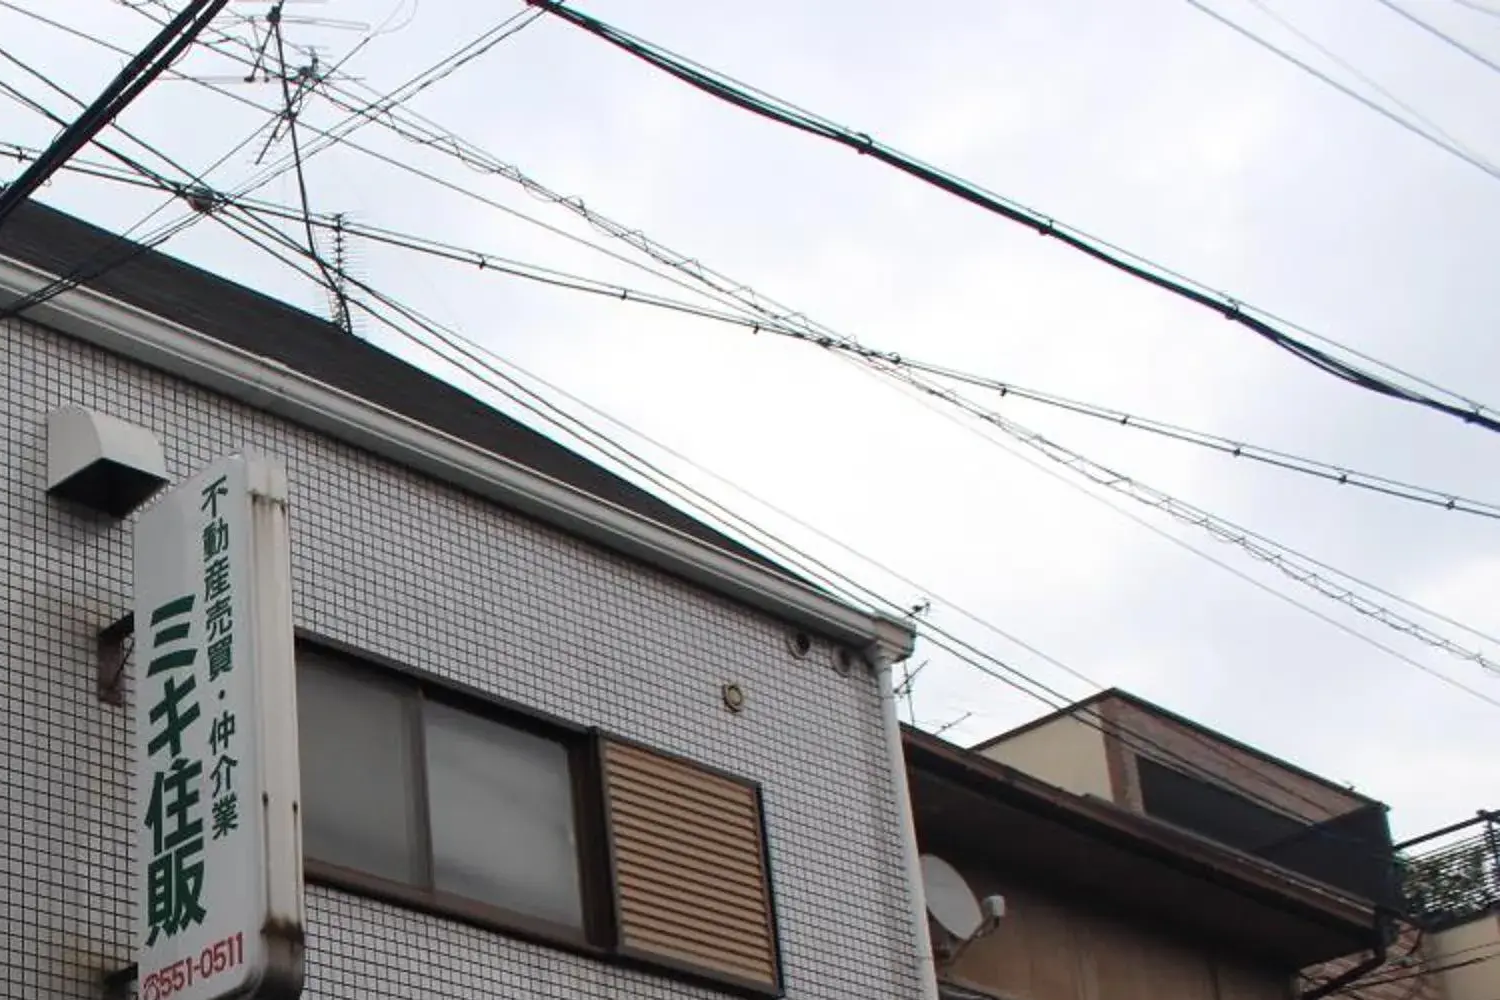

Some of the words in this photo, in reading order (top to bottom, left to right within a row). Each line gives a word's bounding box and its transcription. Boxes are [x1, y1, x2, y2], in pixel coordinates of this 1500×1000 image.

[143, 593, 207, 948] ミキ住販
[200, 474, 239, 838] 不動産売買・仲介業
